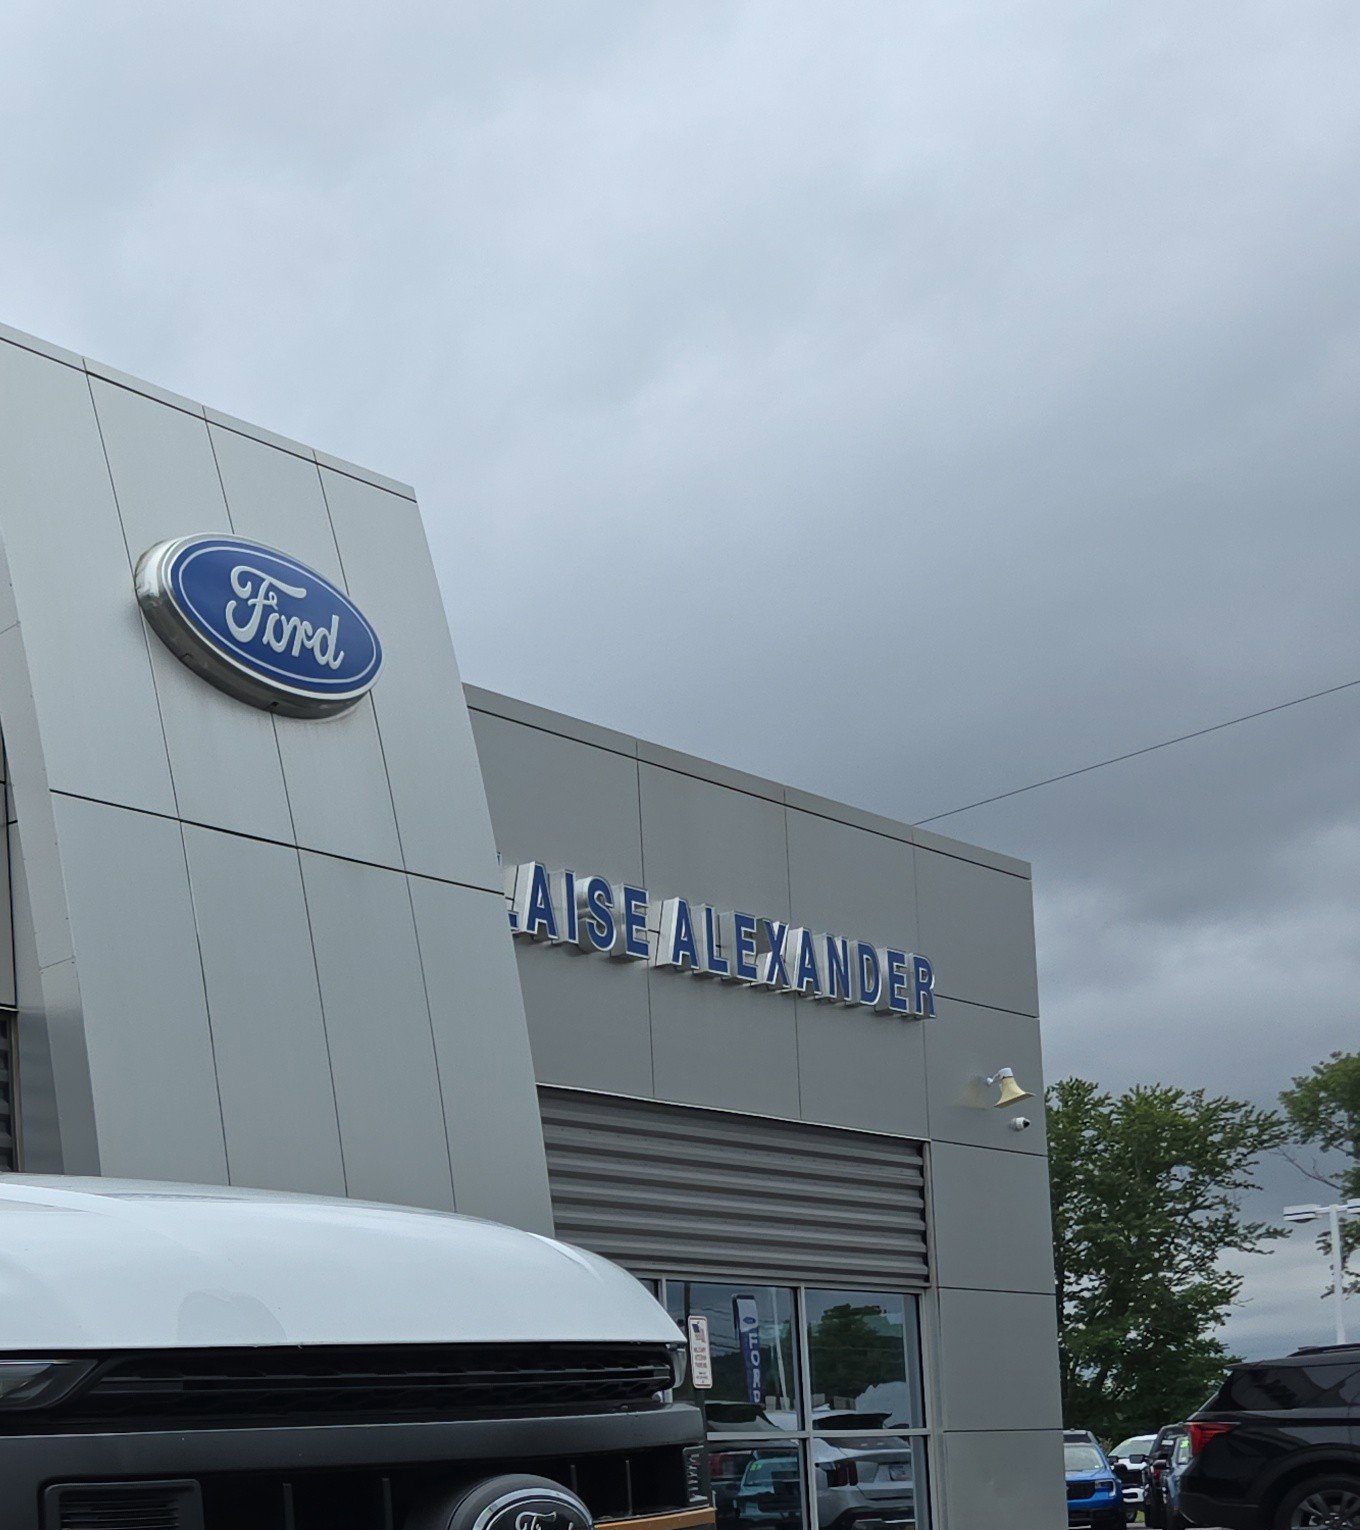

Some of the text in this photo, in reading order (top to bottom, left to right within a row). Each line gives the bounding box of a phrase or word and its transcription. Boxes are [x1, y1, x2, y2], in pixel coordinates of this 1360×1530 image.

[225, 565, 345, 670] Ford
[508, 861, 937, 1019] AISE ALEXANDER
